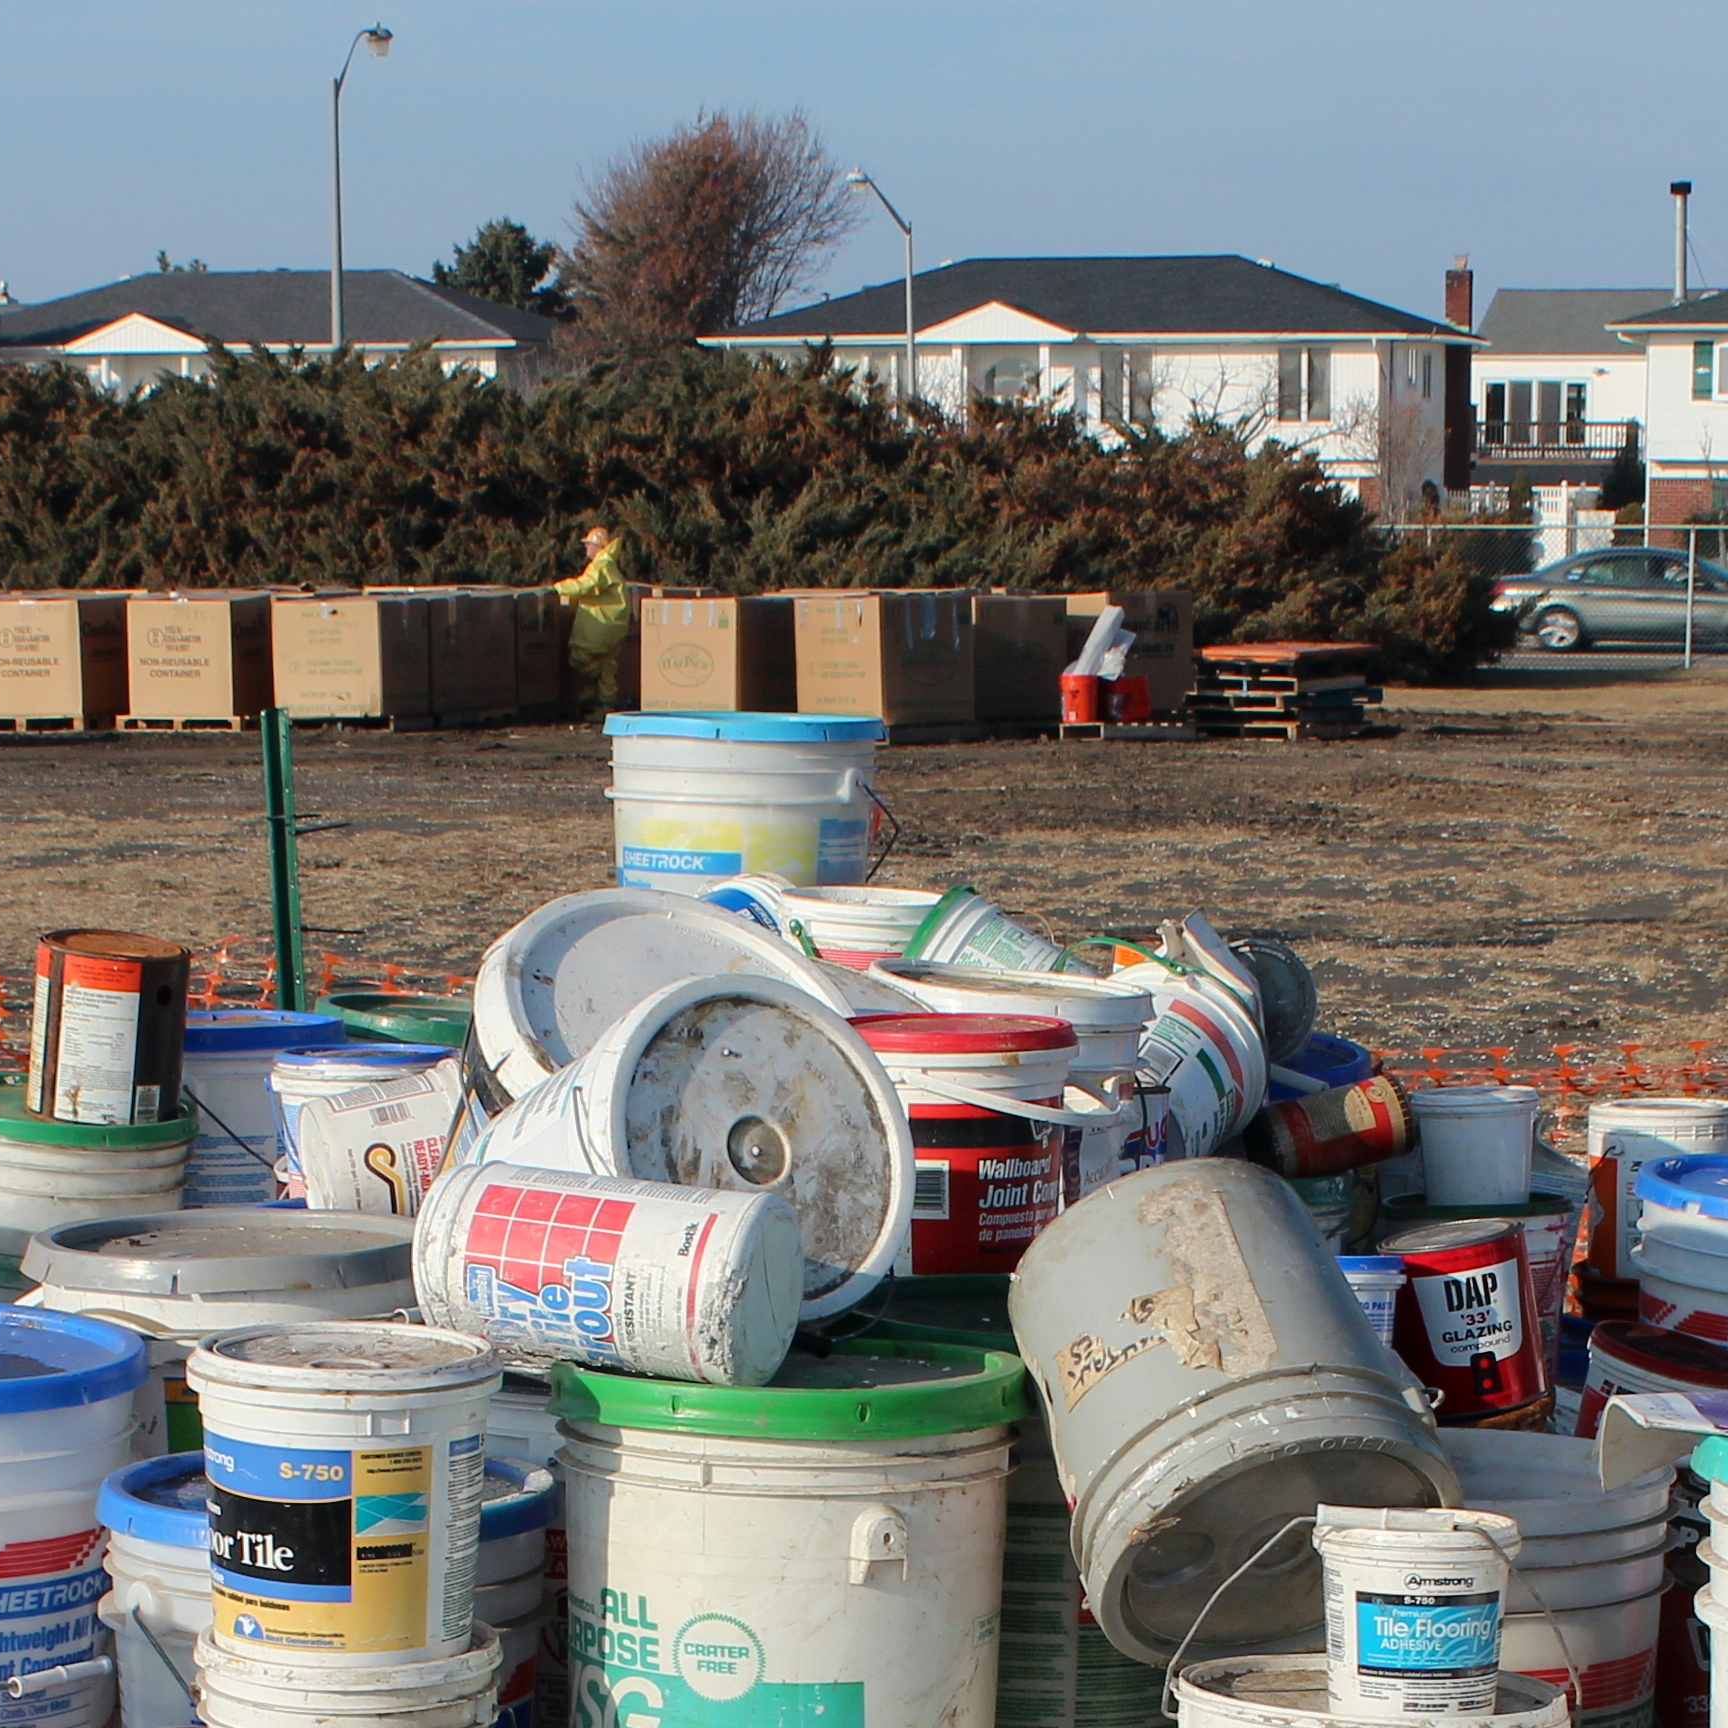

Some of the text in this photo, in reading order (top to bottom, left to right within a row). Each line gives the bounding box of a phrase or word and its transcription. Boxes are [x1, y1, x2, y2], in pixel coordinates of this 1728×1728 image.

[139, 657, 210, 667] NON-REUSABLE
[0, 669, 51, 678] CONTAINER
[149, 669, 202, 678] CONTAINER
[623, 851, 705, 871] SHEETROCK
[979, 1154, 1052, 1180] Wallboard
[979, 1180, 1028, 1209] Joint
[979, 1209, 1033, 1226] Compuesto
[979, 1226, 1032, 1242] de paneles
[1443, 1273, 1498, 1312] DAP
[1442, 1321, 1512, 1343] GLAZING
[1450, 1334, 1511, 1354] compound
[279, 1462, 344, 1482] S-750
[236, 1530, 294, 1572] Tile
[1404, 1572, 1474, 1589] Armstrong
[259, 1601, 290, 1611] baldosas
[601, 1588, 659, 1630] ALL
[1403, 1596, 1436, 1605] S-750
[1392, 1609, 1432, 1618] Premium
[72, 1616, 89, 1635] All
[1373, 1616, 1492, 1644] Tile Flooring
[266, 1633, 334, 1647] Next Generation
[1380, 1638, 1442, 1651] ADHESIVE
[684, 1642, 750, 1660] CRATER
[697, 1659, 738, 1676] FREE
[28, 1704, 48, 1716] Over
[50, 1699, 71, 1712] Metal
